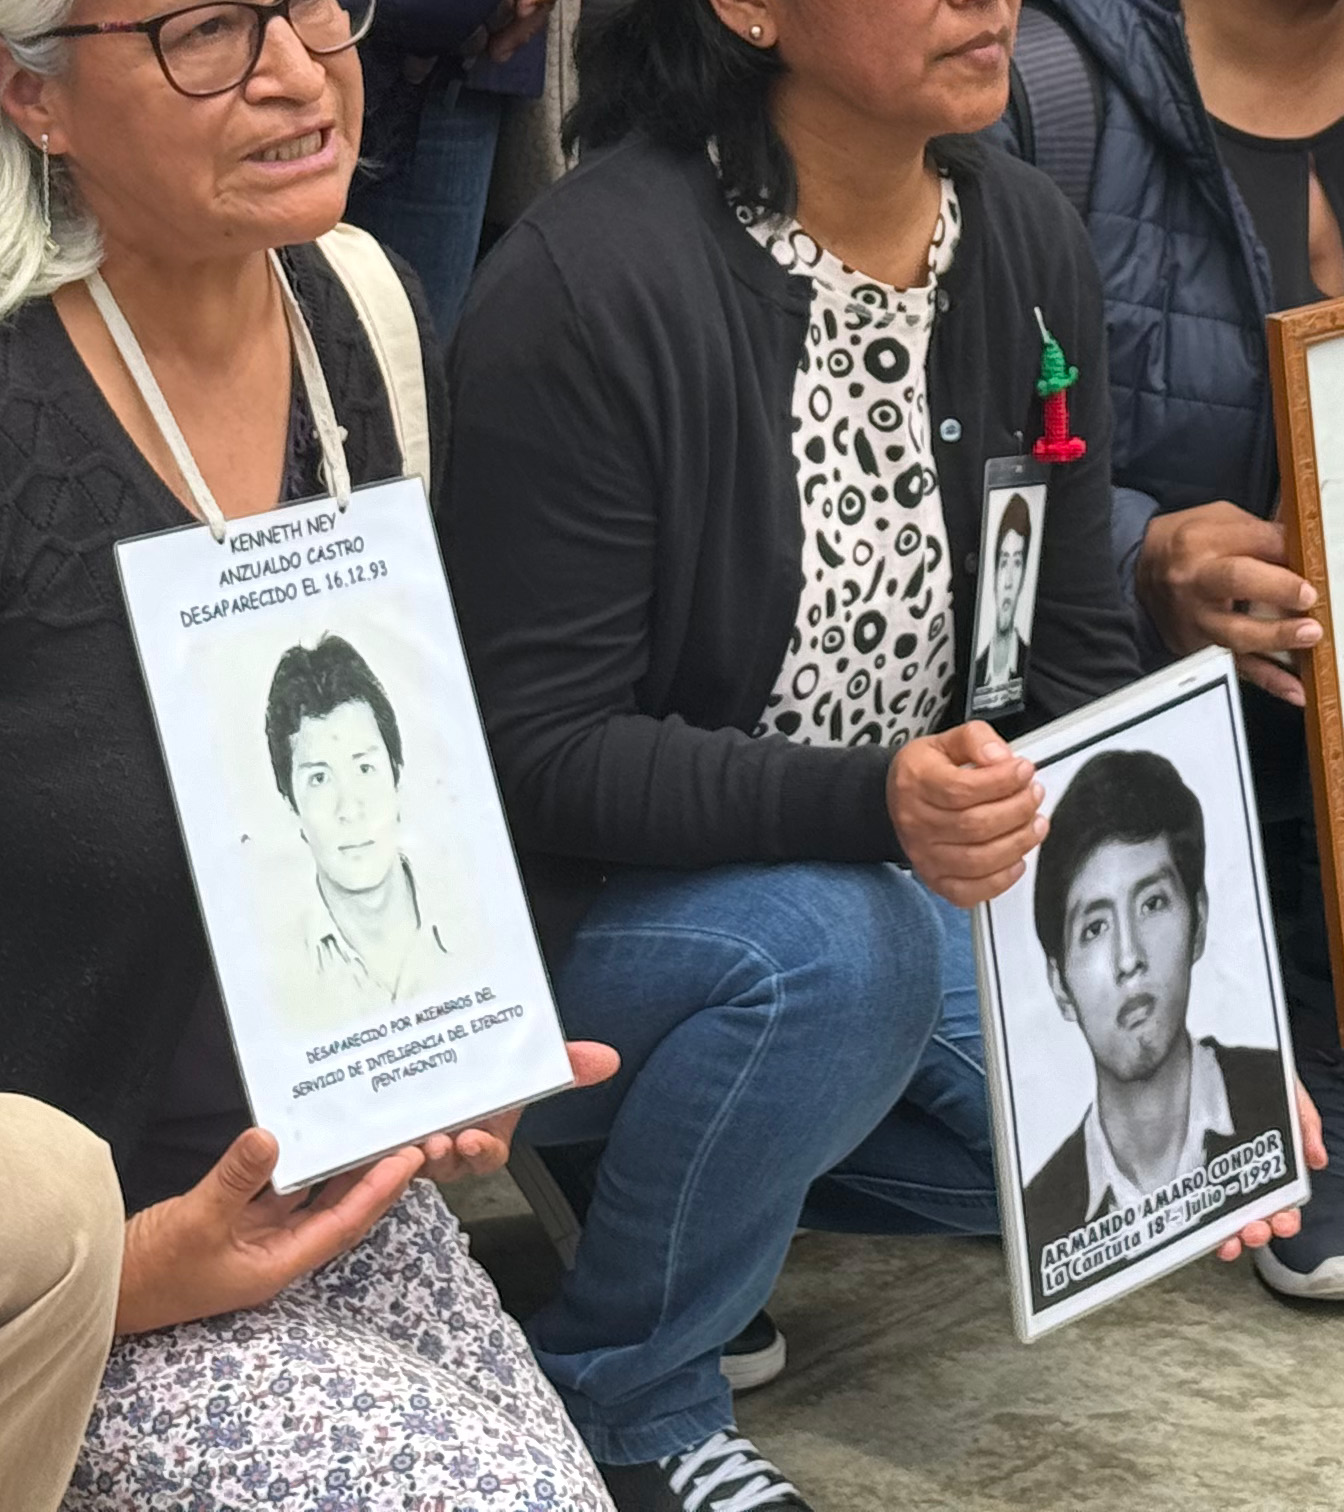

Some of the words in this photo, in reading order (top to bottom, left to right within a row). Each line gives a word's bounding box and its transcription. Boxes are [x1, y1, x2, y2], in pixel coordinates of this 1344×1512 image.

[219, 552, 302, 588] ANZUALDO
[307, 536, 365, 565] CASTRO
[229, 520, 303, 555] KENNETH
[307, 513, 337, 536] NEY
[180, 582, 298, 628] DESAPARECIDO
[302, 577, 322, 597] EL
[326, 559, 389, 590] 16.12.93
[292, 1068, 346, 1099] SERVICIO
[348, 1060, 365, 1079] DE
[366, 1032, 446, 1072] INTELIGENCIA
[447, 1024, 469, 1042] DEL
[470, 1004, 524, 1035] EJERCITO
[305, 1024, 388, 1065] DESAPARECIDO
[390, 1015, 412, 1034] POR
[416, 994, 473, 1026] MIEMBROS
[475, 986, 497, 1004] DEL
[1043, 1207, 1136, 1270] ARMANDO
[1142, 1170, 1205, 1219] AMARO
[1210, 1132, 1280, 1180] CONDOR
[1072, 1232, 1143, 1278] Cantuta
[1184, 1189, 1222, 1223] Julio
[1242, 1153, 1285, 1187] 1992
